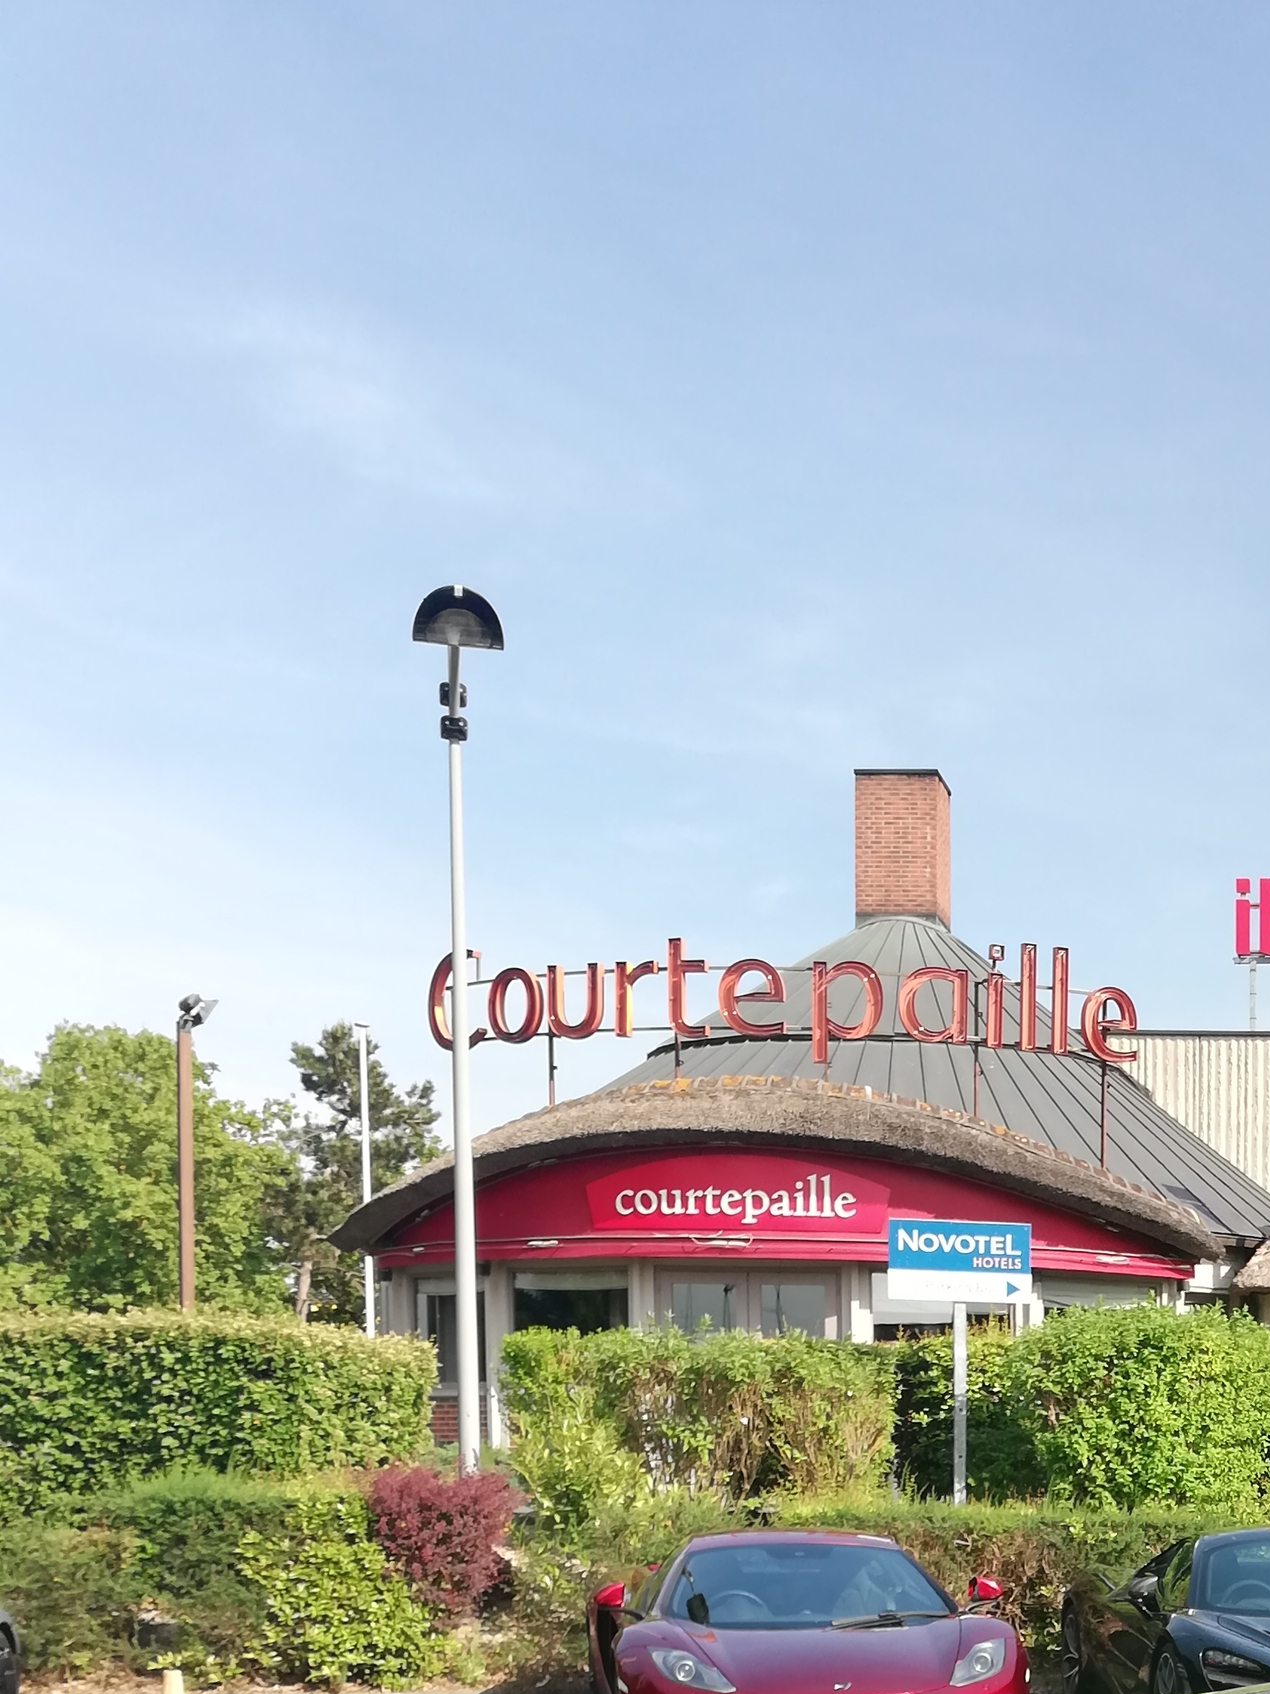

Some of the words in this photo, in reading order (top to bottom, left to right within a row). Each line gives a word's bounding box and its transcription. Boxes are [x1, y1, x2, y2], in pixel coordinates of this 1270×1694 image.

[428, 938, 1138, 1063] Courtepaille
[614, 1175, 857, 1225] courtepaille
[897, 1228, 1022, 1256] NOVOTEL
[973, 1257, 1022, 1270] HOTELS
